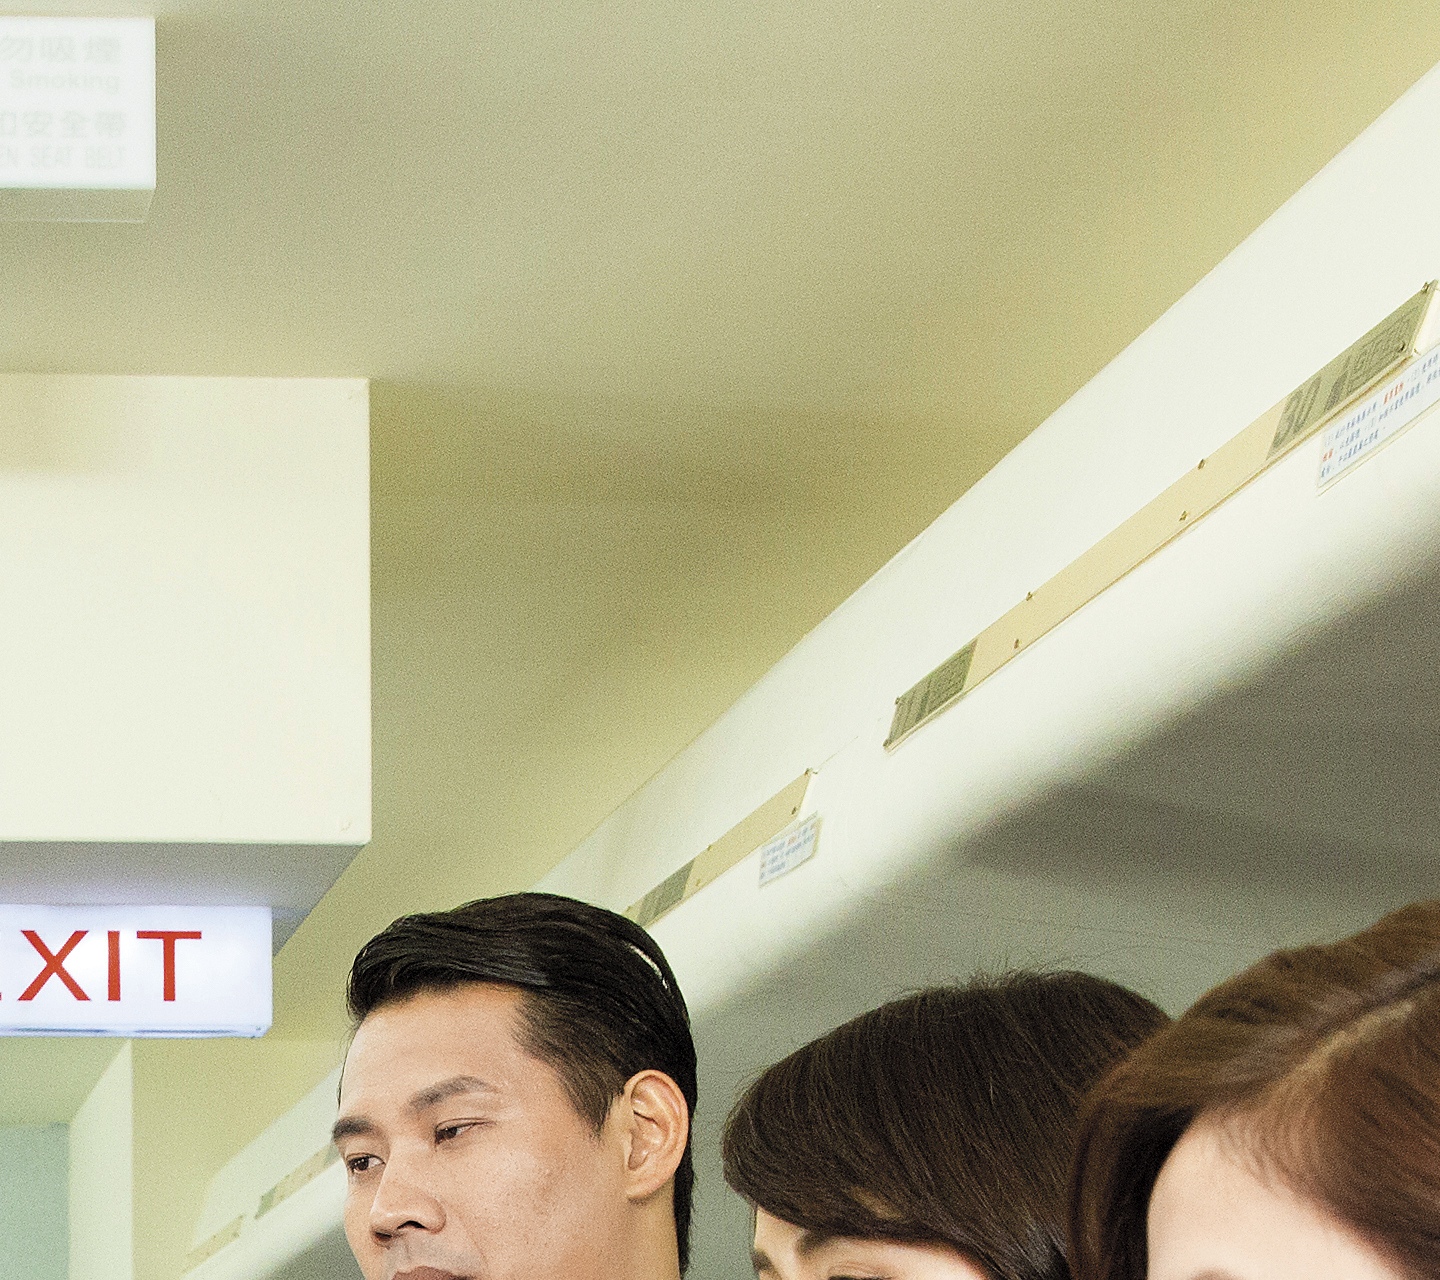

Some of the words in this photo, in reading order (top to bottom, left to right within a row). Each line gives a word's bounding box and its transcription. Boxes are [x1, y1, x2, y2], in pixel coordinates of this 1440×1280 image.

[9, 68, 120, 95] Smoking
[29, 144, 74, 169] SEAT
[84, 145, 128, 170] BELT
